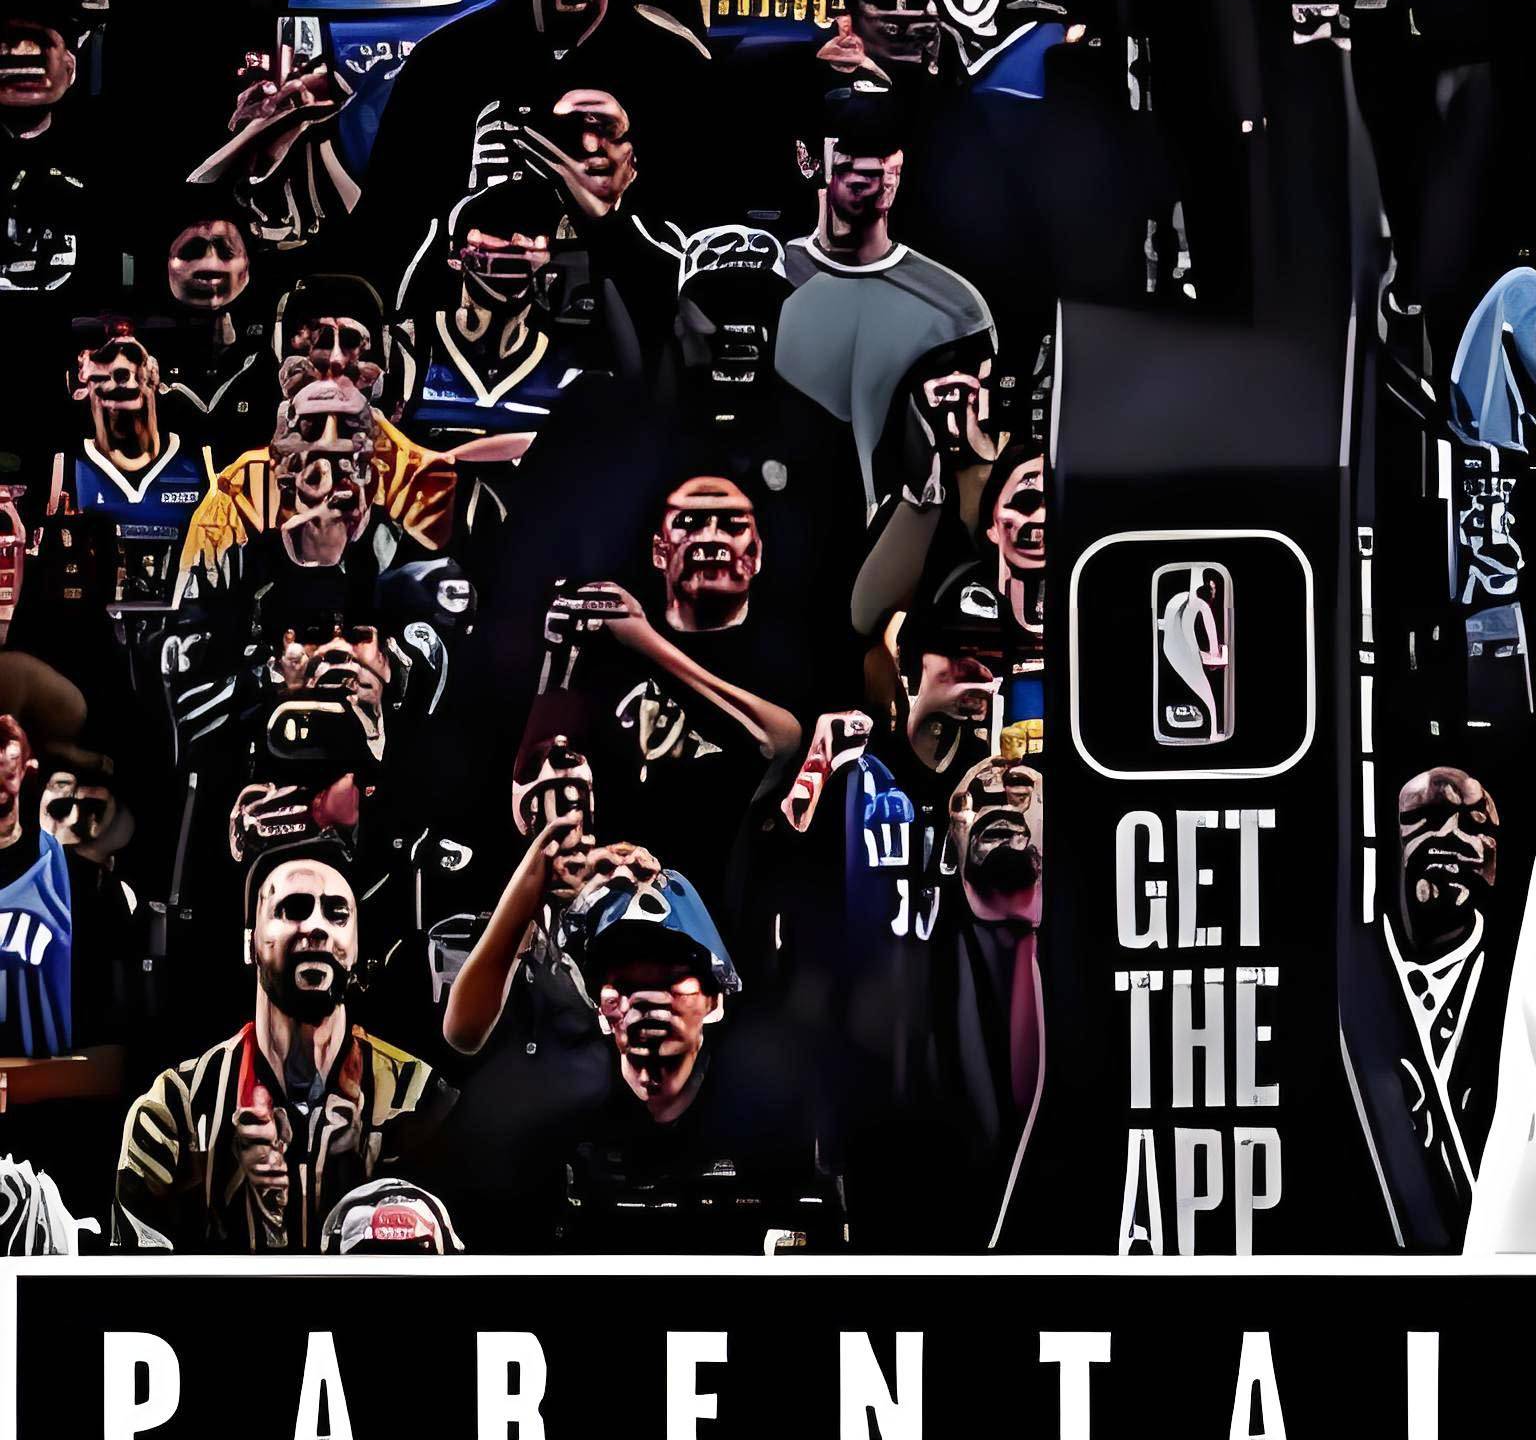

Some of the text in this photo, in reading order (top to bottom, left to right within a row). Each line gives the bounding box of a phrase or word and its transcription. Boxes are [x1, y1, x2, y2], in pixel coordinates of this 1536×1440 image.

[1116, 809, 1276, 949] GET
[1114, 967, 1280, 1109] THE
[1118, 1127, 1282, 1255] APP
